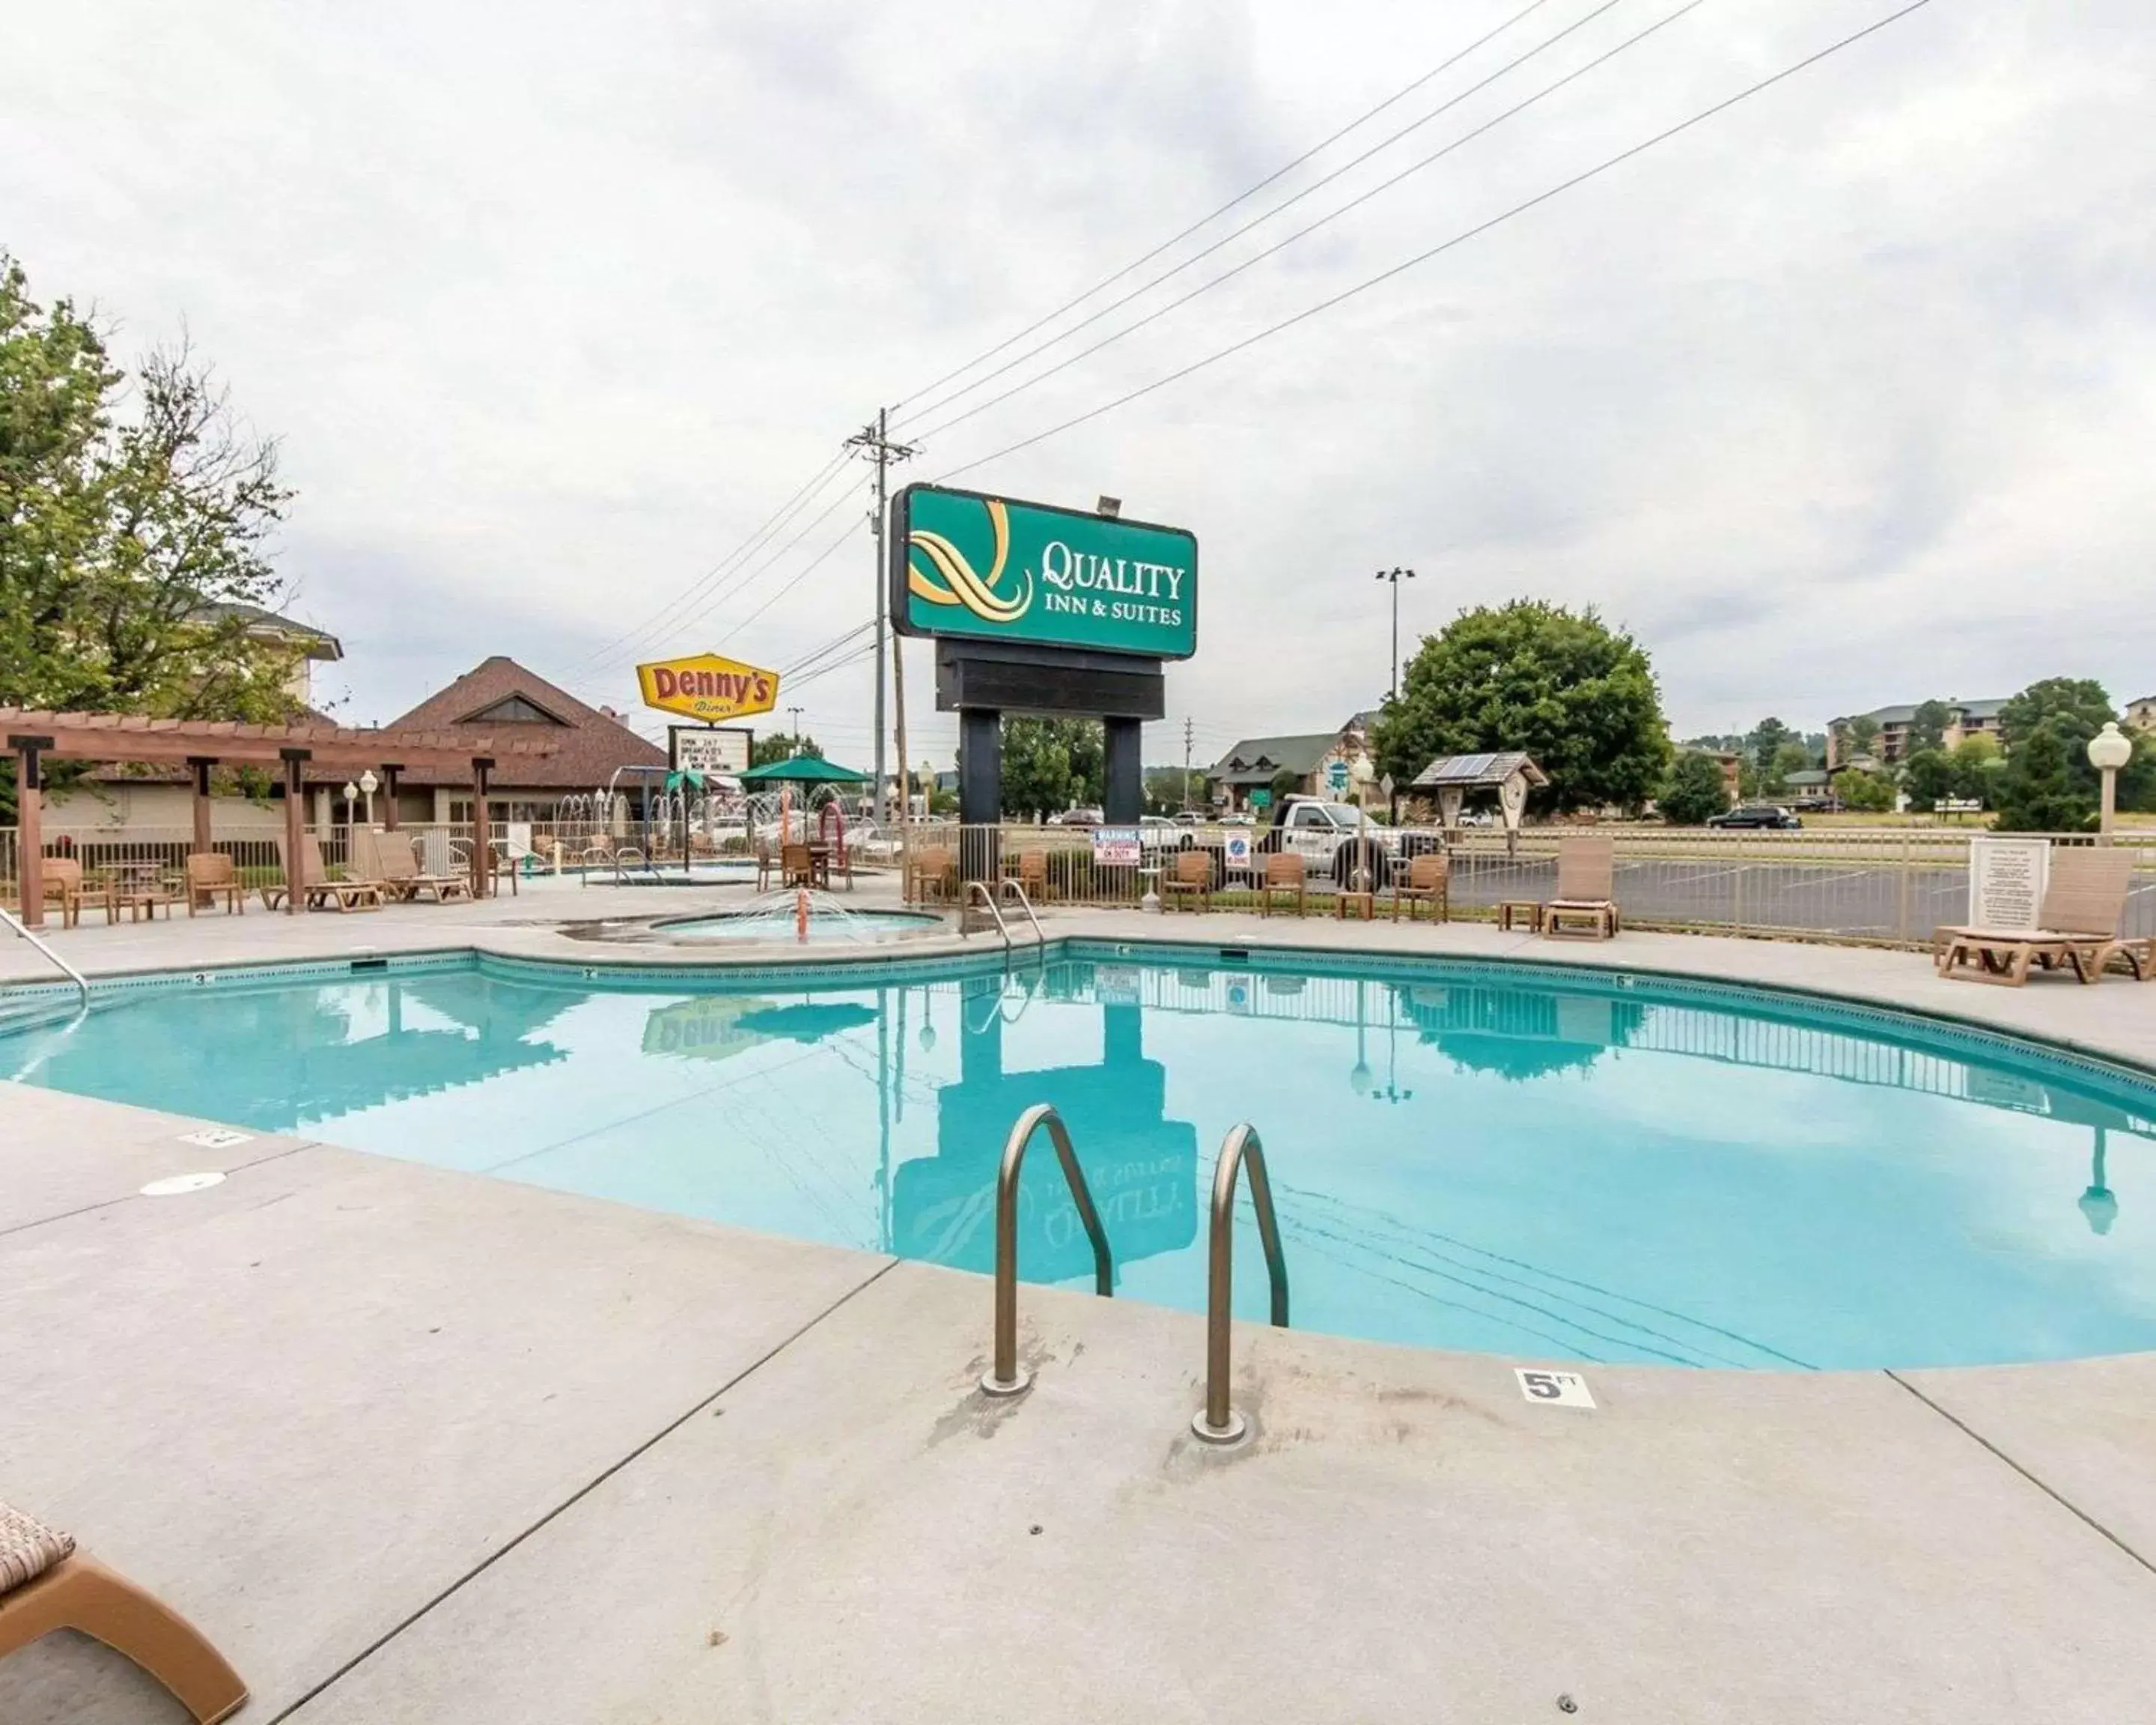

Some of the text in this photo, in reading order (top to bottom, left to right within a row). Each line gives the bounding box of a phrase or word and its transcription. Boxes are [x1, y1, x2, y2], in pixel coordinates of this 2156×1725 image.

[1042, 541, 1185, 600] QUALITY
[1045, 593, 1181, 626] INN & SUITES
[654, 668, 770, 704] Denny's
[1523, 1373, 1561, 1399] 5
